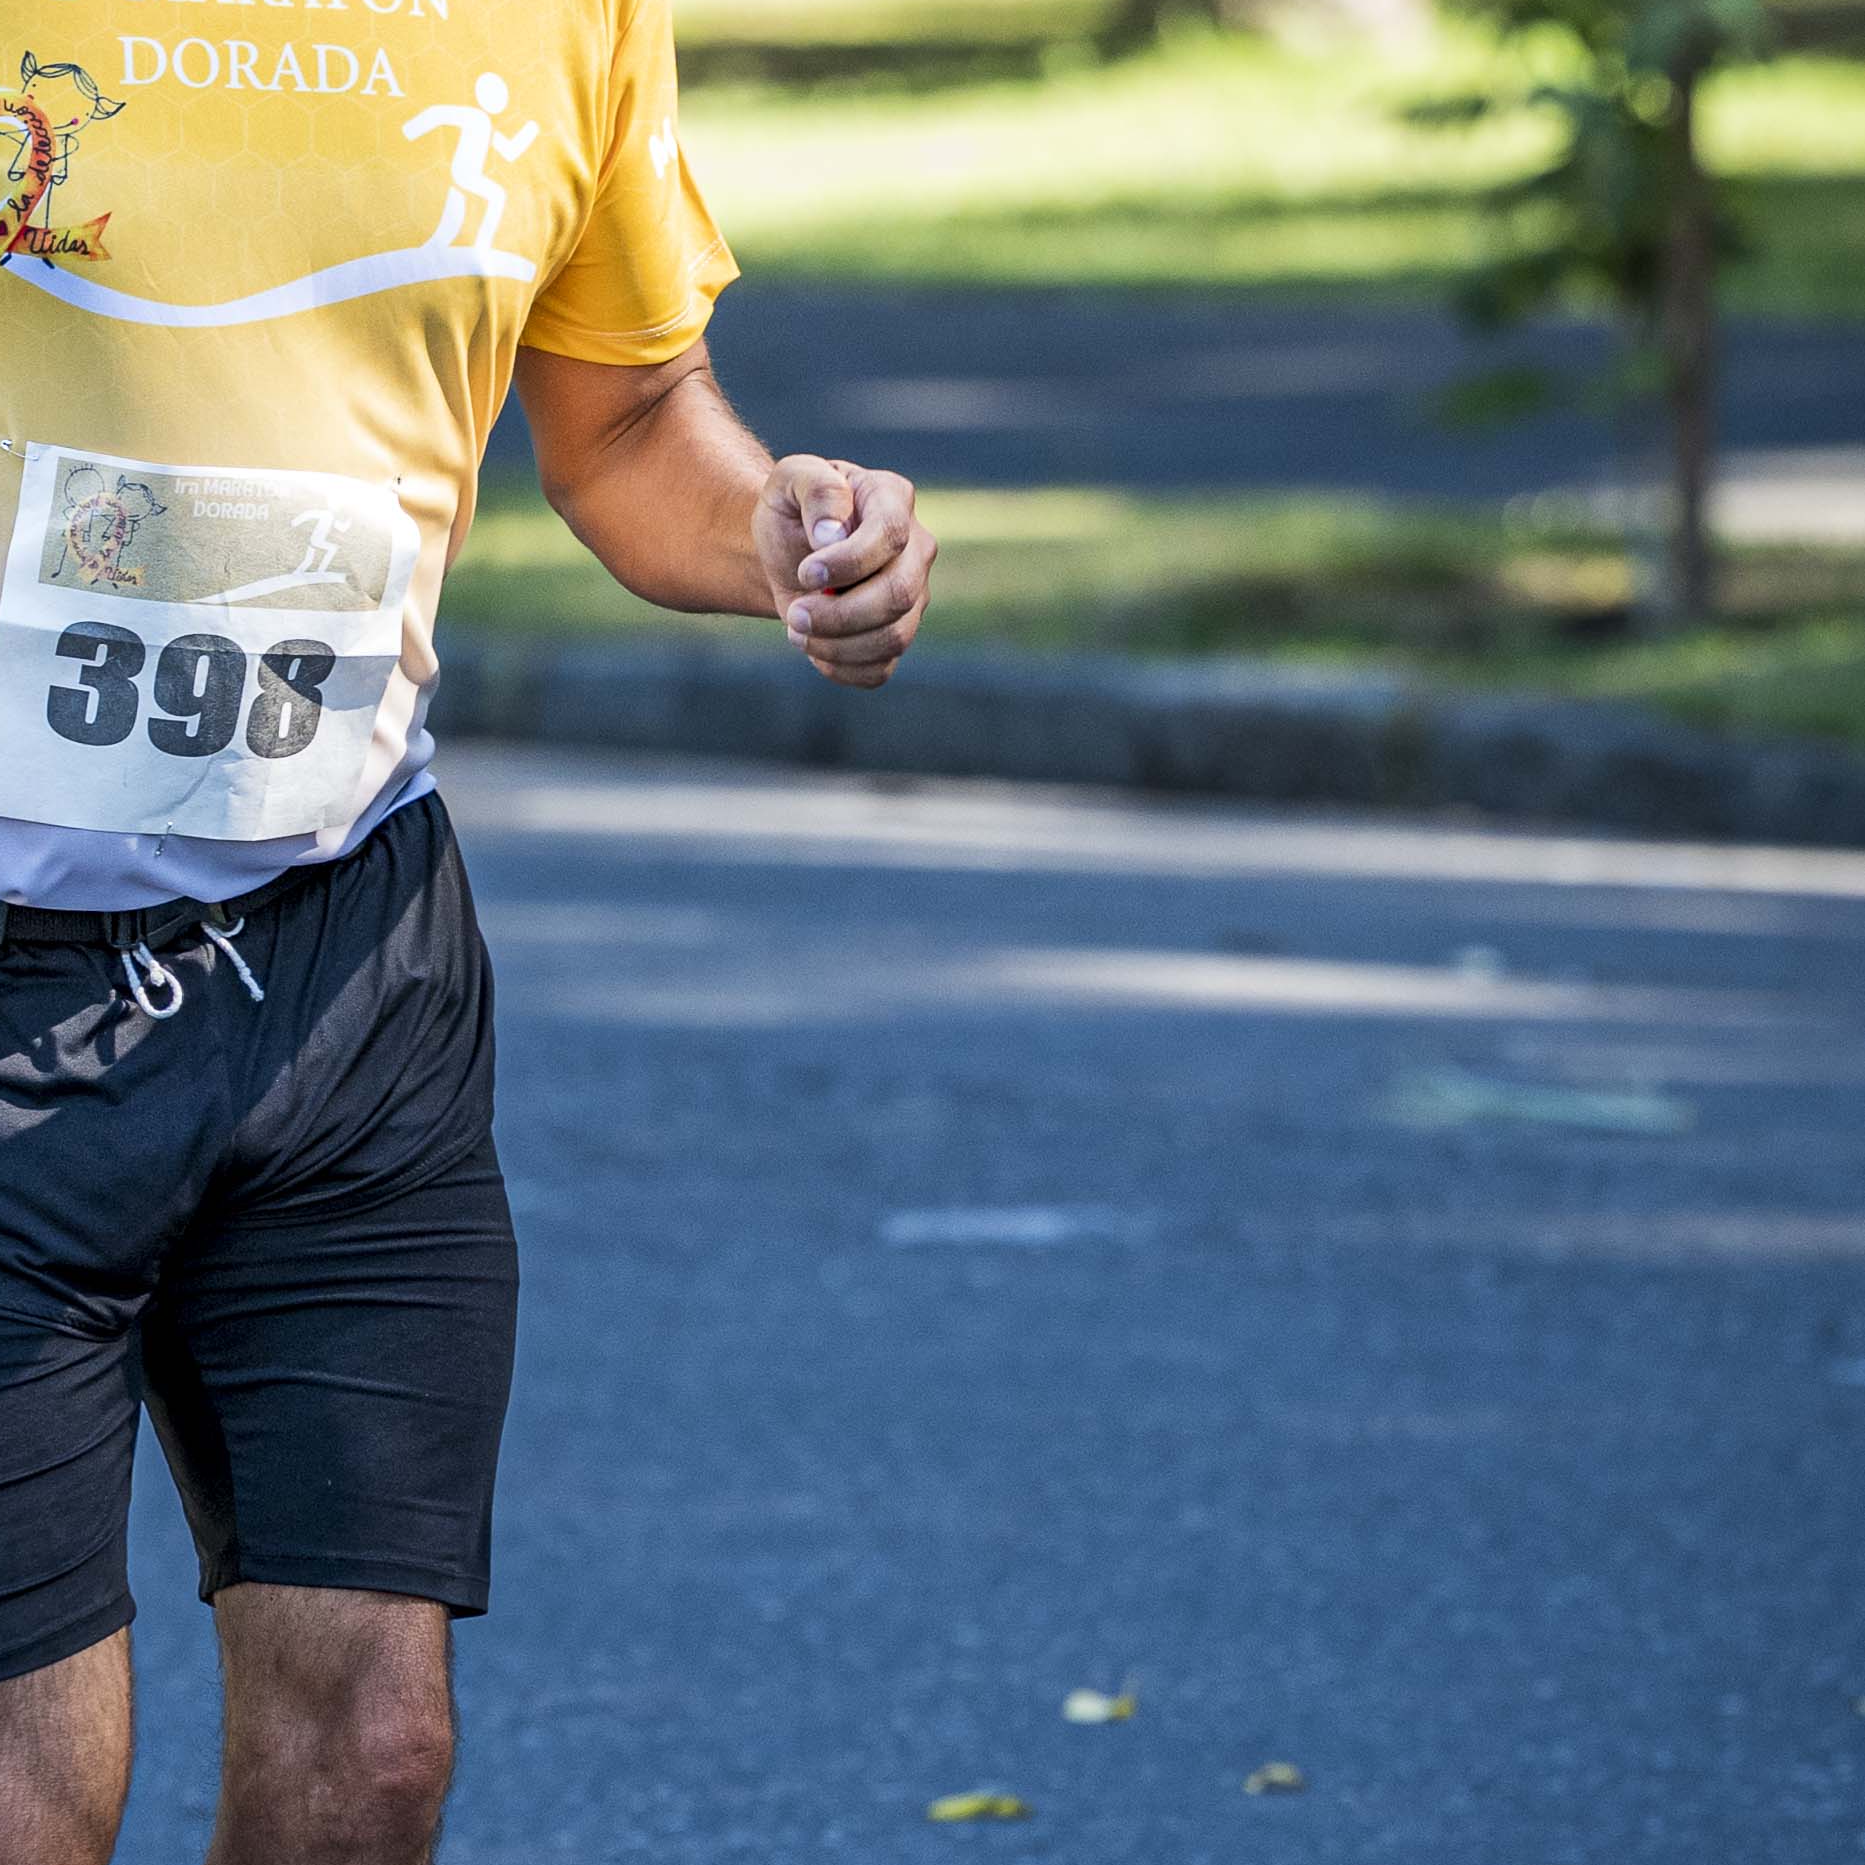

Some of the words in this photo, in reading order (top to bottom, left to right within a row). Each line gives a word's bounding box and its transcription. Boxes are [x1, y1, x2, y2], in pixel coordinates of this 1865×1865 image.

[116, 36, 406, 97] DORADA
[192, 499, 270, 521] DORADA
[46, 621, 336, 759] 398
